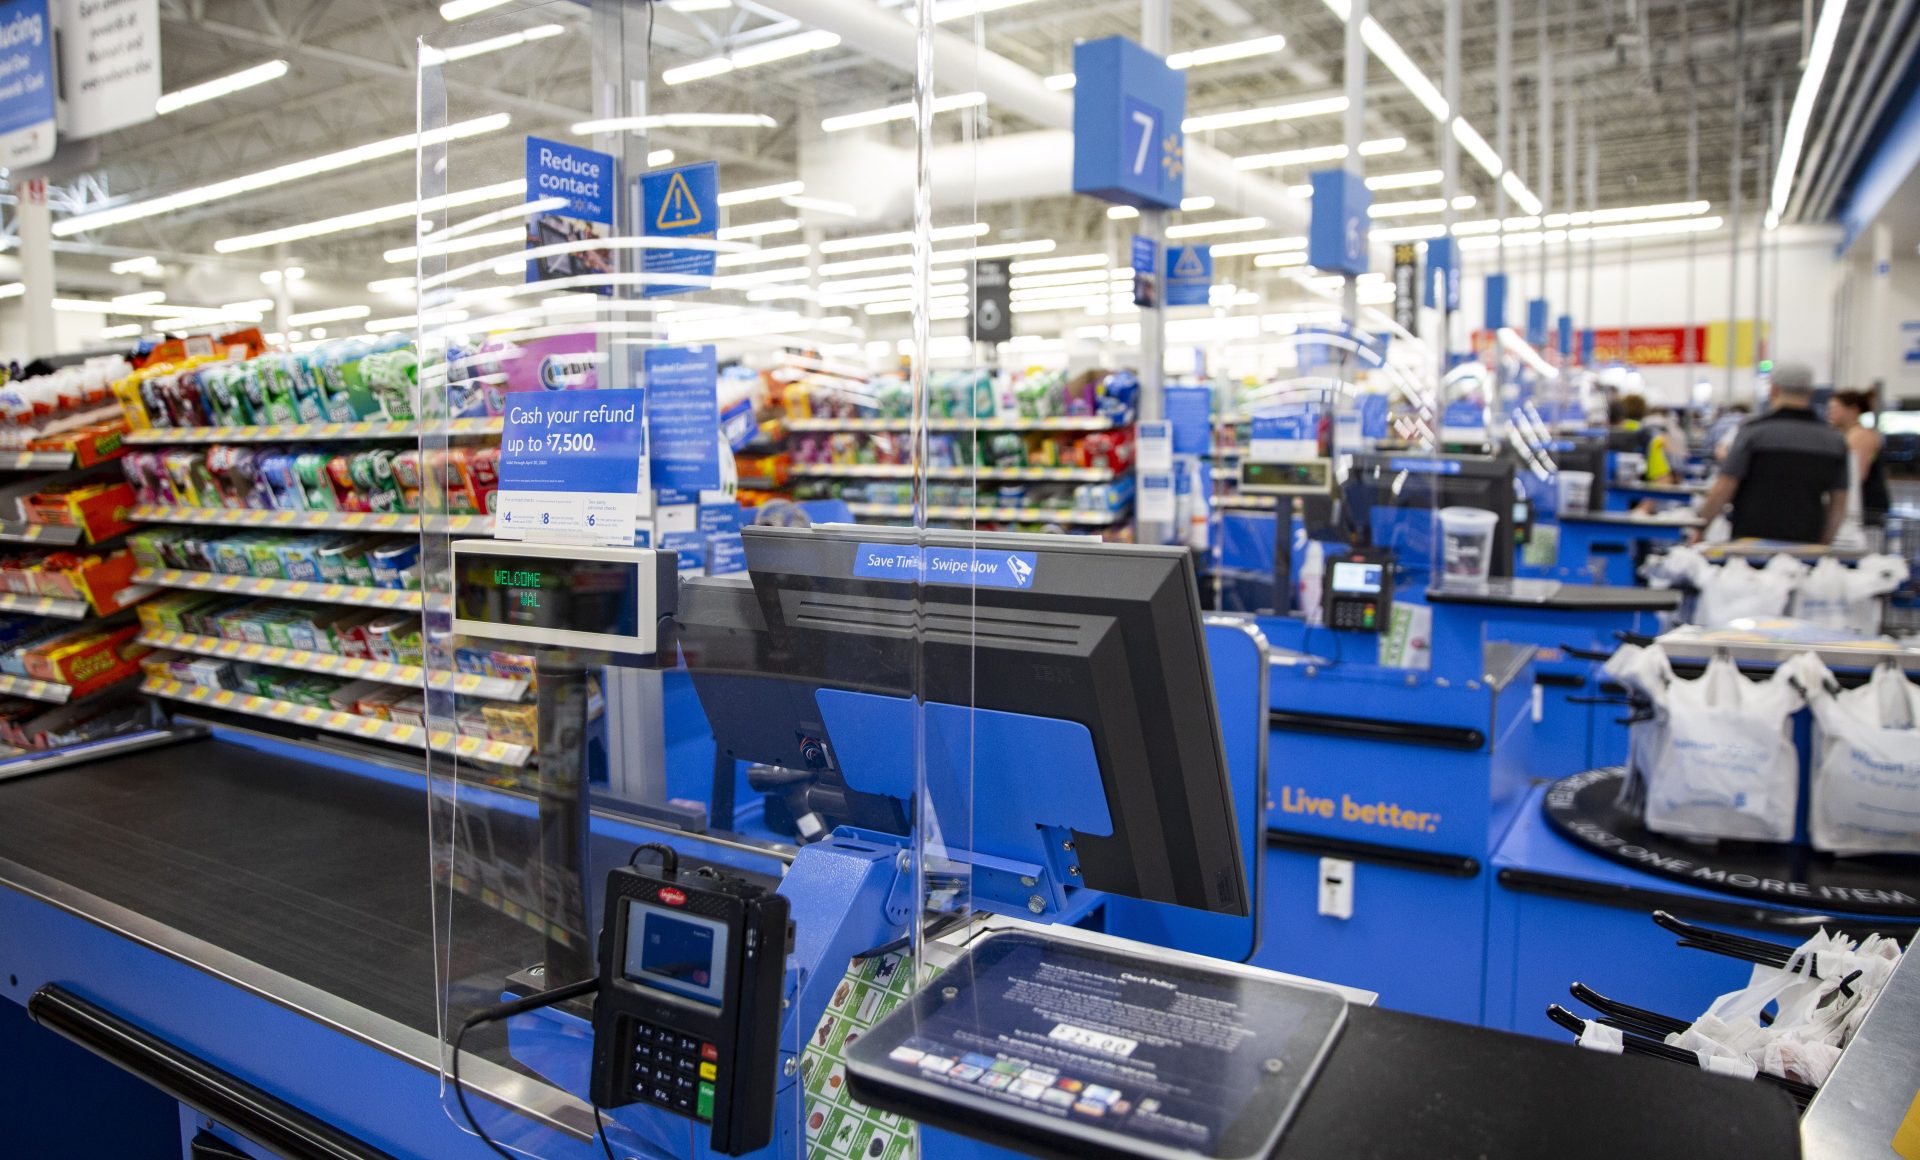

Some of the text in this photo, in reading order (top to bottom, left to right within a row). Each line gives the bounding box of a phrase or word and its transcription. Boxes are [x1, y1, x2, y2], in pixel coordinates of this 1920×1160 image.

[1132, 110, 1154, 175] 7
[540, 147, 600, 178] Reduce
[539, 173, 600, 198] contact
[510, 404, 635, 428] Cash your refund
[507, 433, 596, 456] up to $7,500.
[867, 554, 894, 568] Save
[931, 557, 968, 573] Swipe
[970, 560, 999, 575] Now
[494, 569, 541, 588] WELCOME
[520, 591, 541, 608] WAL
[1282, 786, 1335, 818] Live
[1619, 845, 1695, 872] ONE
[1693, 867, 1812, 897] MORE
[1120, 972, 1148, 984] Check
